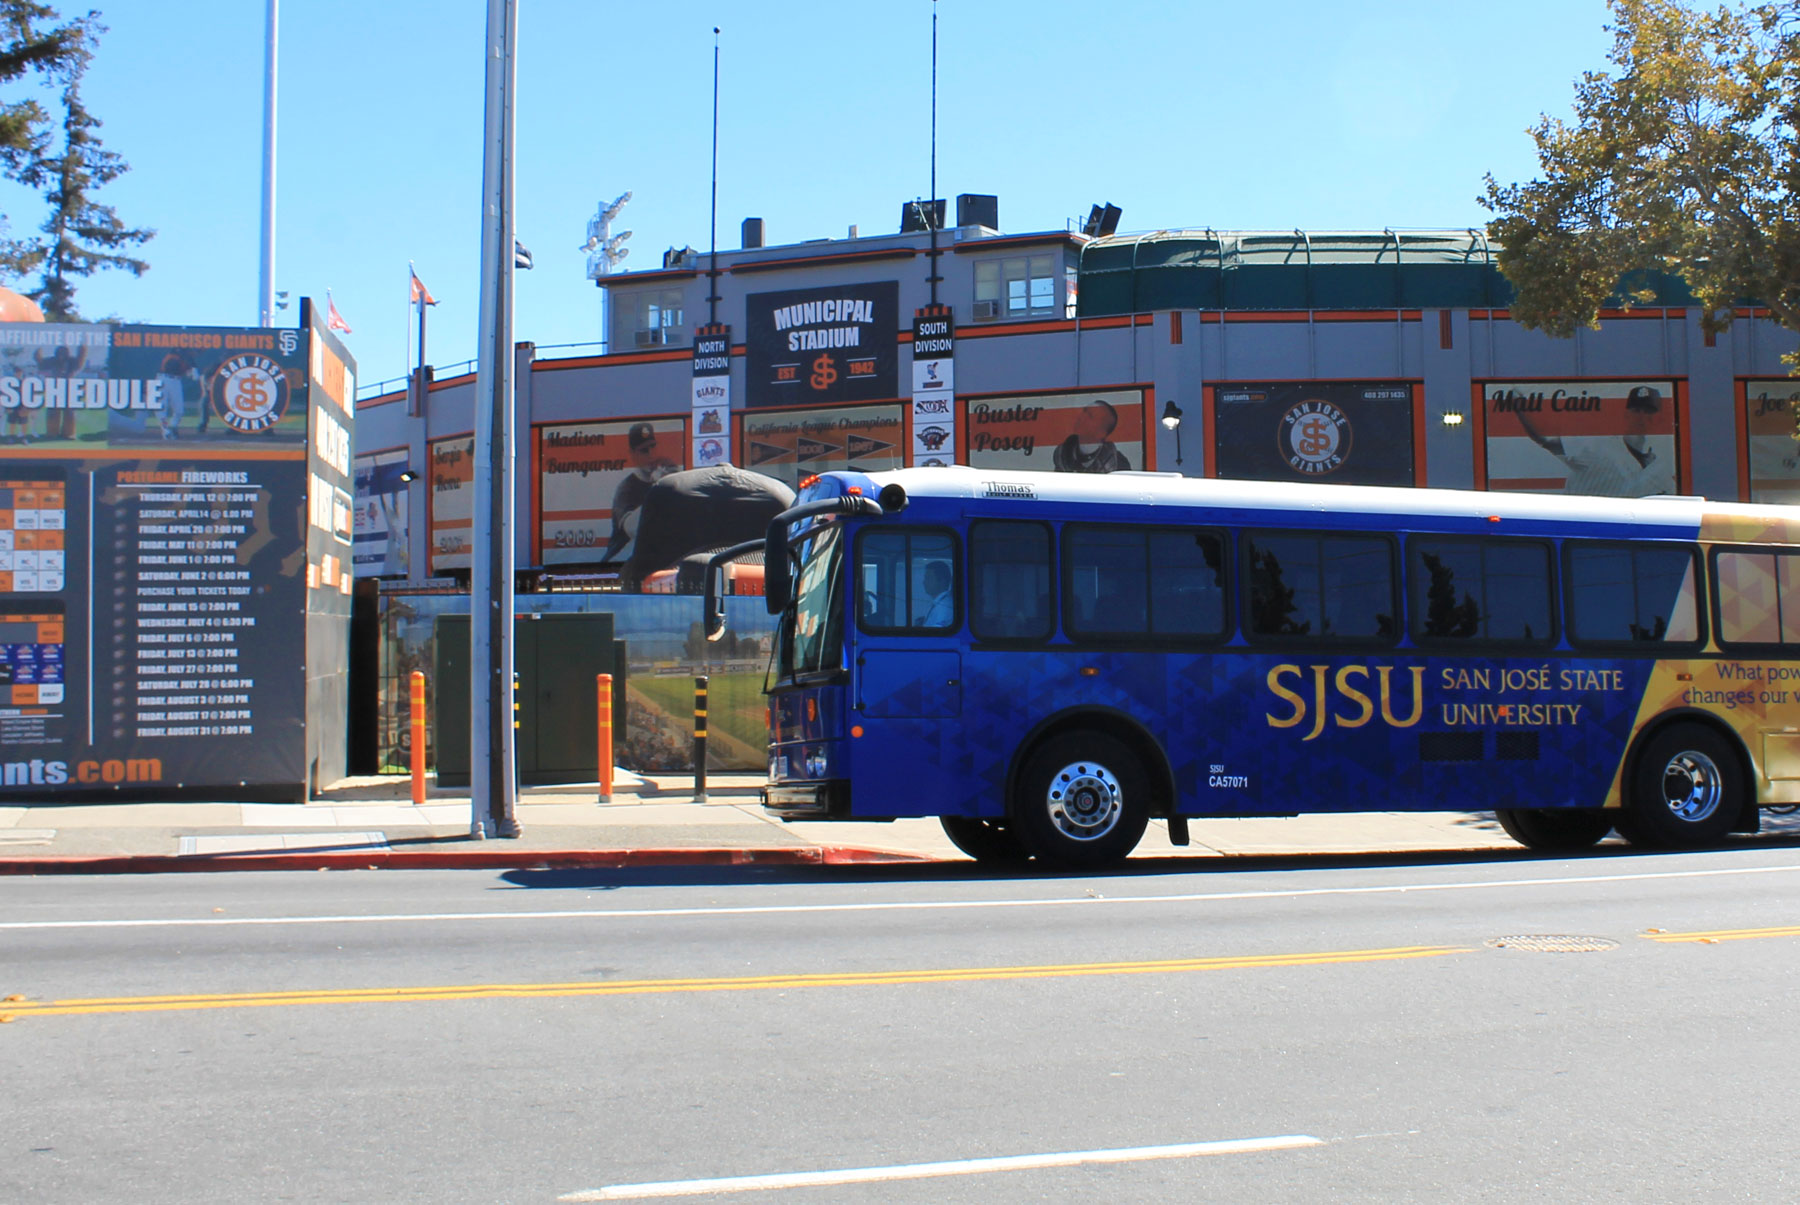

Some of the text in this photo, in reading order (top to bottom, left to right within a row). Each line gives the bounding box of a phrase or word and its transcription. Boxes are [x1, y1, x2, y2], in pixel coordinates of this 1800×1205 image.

[773, 299, 873, 331] MUNICIPAL
[919, 322, 947, 335] SOUTH
[64, 331, 83, 346] OF
[85, 331, 112, 346] THE
[113, 332, 141, 347] SAN
[144, 332, 222, 349] FRANCISCO
[225, 334, 274, 350] GIANTS
[788, 326, 860, 351] STADIUM
[915, 338, 952, 352] DIVISION
[698, 341, 725, 353] NORTH
[220, 356, 286, 383] SAN JOSE
[694, 357, 728, 370] DIVISION
[849, 361, 875, 374] 1942
[777, 367, 796, 380] EST
[0, 376, 164, 410] SCHEDULE
[696, 386, 726, 398] GIANTS
[1492, 389, 1602, 413] Matt Cain
[224, 410, 279, 431] GIANTS
[974, 404, 1044, 425] Buster
[1285, 402, 1347, 427] SAN JOSE
[748, 416, 899, 438] California League Champions
[546, 430, 605, 448] Madison
[974, 432, 1035, 456] Posey
[546, 458, 627, 478] Bumgarner
[1290, 454, 1342, 473] GIANTS
[181, 471, 248, 484] FIREWORKS
[983, 481, 1034, 493] Thomas
[183, 493, 205, 502] APRIL
[245, 493, 258, 502] PM
[241, 510, 254, 518] PM
[232, 525, 246, 534] PM
[168, 541, 186, 549] MAY
[224, 541, 237, 549] PM
[554, 529, 596, 548] 2009
[168, 556, 187, 564] JUNE
[222, 556, 235, 564] PM
[181, 571, 200, 580] JUNE
[237, 571, 250, 580] PM
[137, 587, 251, 596] PURCHASE YOUR TICKETS TODAY
[168, 603, 187, 611] JUNE
[227, 602, 240, 611] PM
[188, 618, 206, 626] JULY
[242, 618, 256, 626] PM
[167, 634, 185, 642] JULY
[221, 633, 234, 642] PM
[167, 650, 185, 658] JULY
[225, 649, 238, 657] PM
[167, 665, 185, 673] JULY
[225, 664, 238, 673] PM
[1716, 663, 1763, 680] What
[180, 680, 198, 689] JULY
[240, 680, 253, 688] PM
[1442, 664, 1625, 694] SAN JOSÉ STATE
[167, 696, 199, 705] AUGUST
[235, 695, 248, 704] PM
[1266, 664, 1426, 742] SJSU
[1681, 686, 1755, 710] changes
[1760, 691, 1788, 704] our
[167, 712, 199, 720] AUGUST
[238, 711, 251, 719] PM
[1443, 703, 1582, 726] UNIVERSITY
[167, 727, 199, 736] AUGUST
[239, 726, 252, 735] PM
[0, 757, 162, 786] nts.com
[1210, 764, 1224, 774] SJSU
[1209, 775, 1248, 788] CA57071
